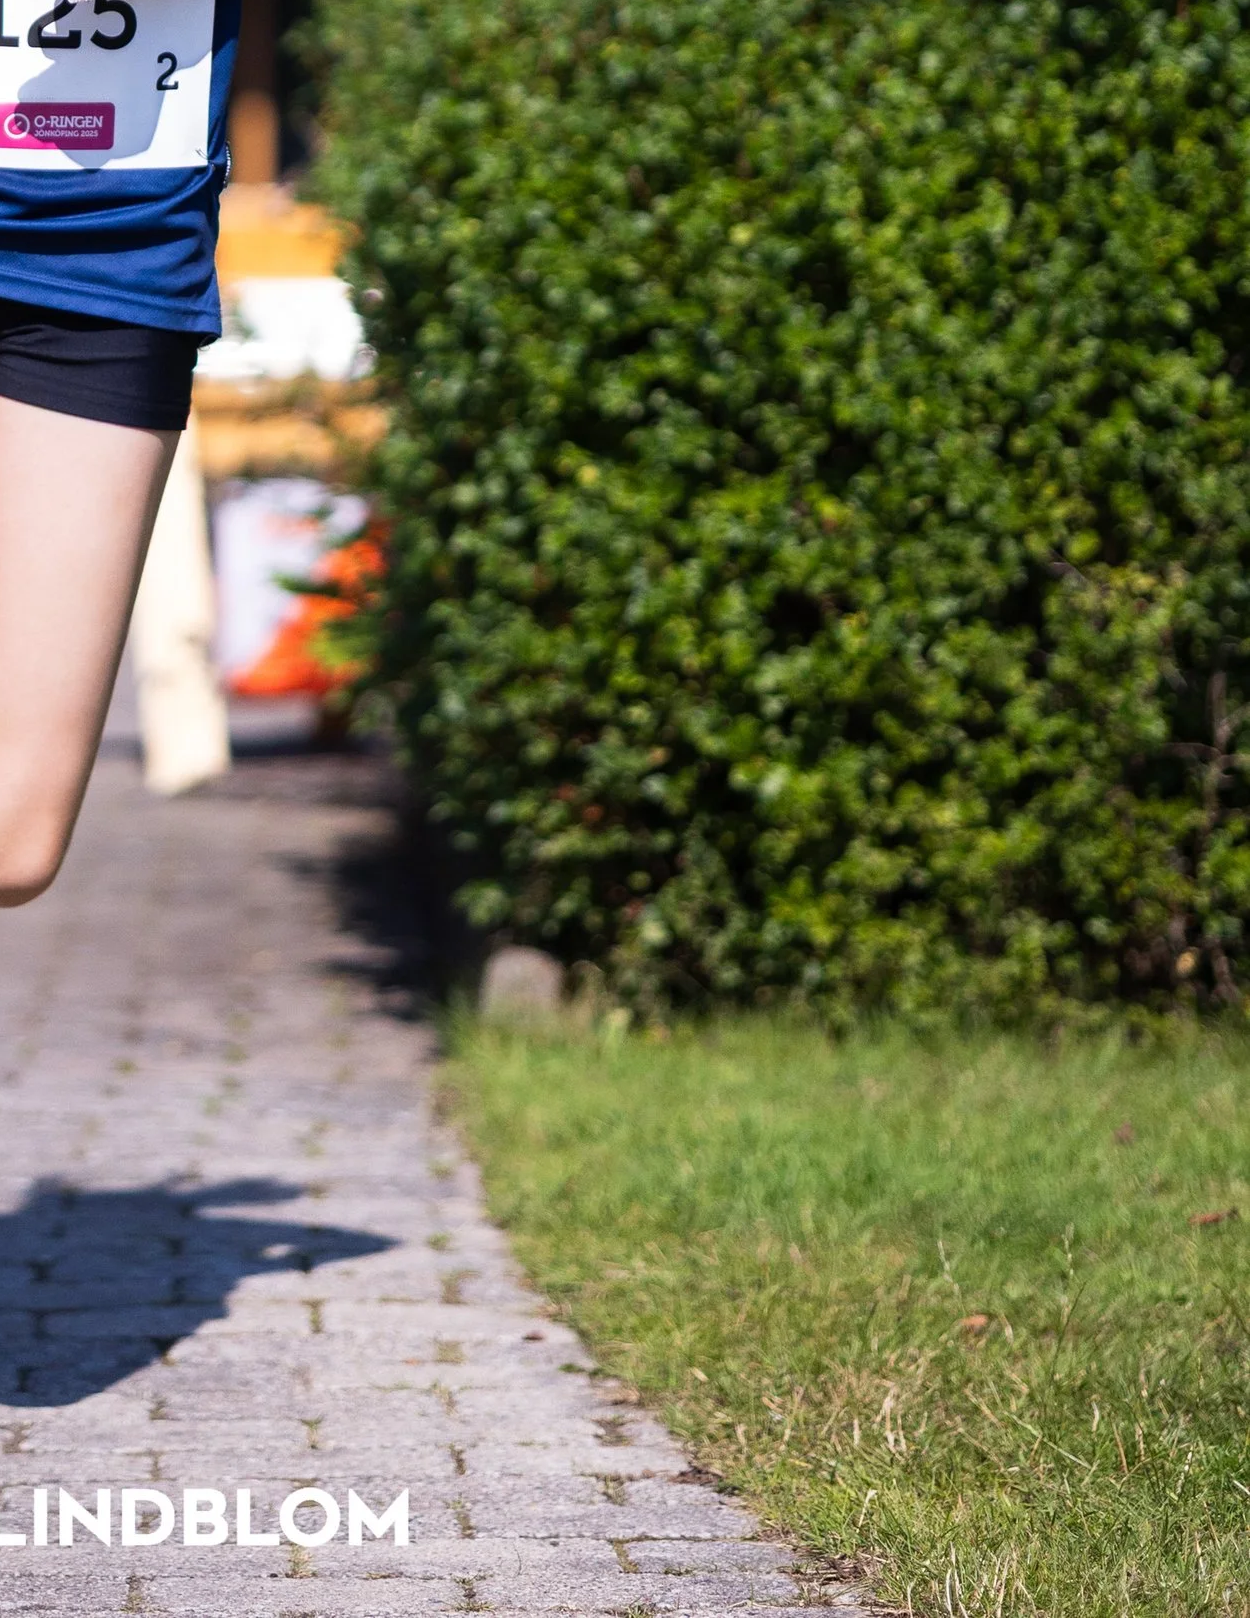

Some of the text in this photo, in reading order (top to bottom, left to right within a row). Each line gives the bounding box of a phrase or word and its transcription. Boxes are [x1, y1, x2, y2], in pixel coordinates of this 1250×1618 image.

[155, 51, 180, 91] 2
[33, 114, 104, 129] O-RINGEN
[34, 128, 99, 138] JÖNKÖPING 2025
